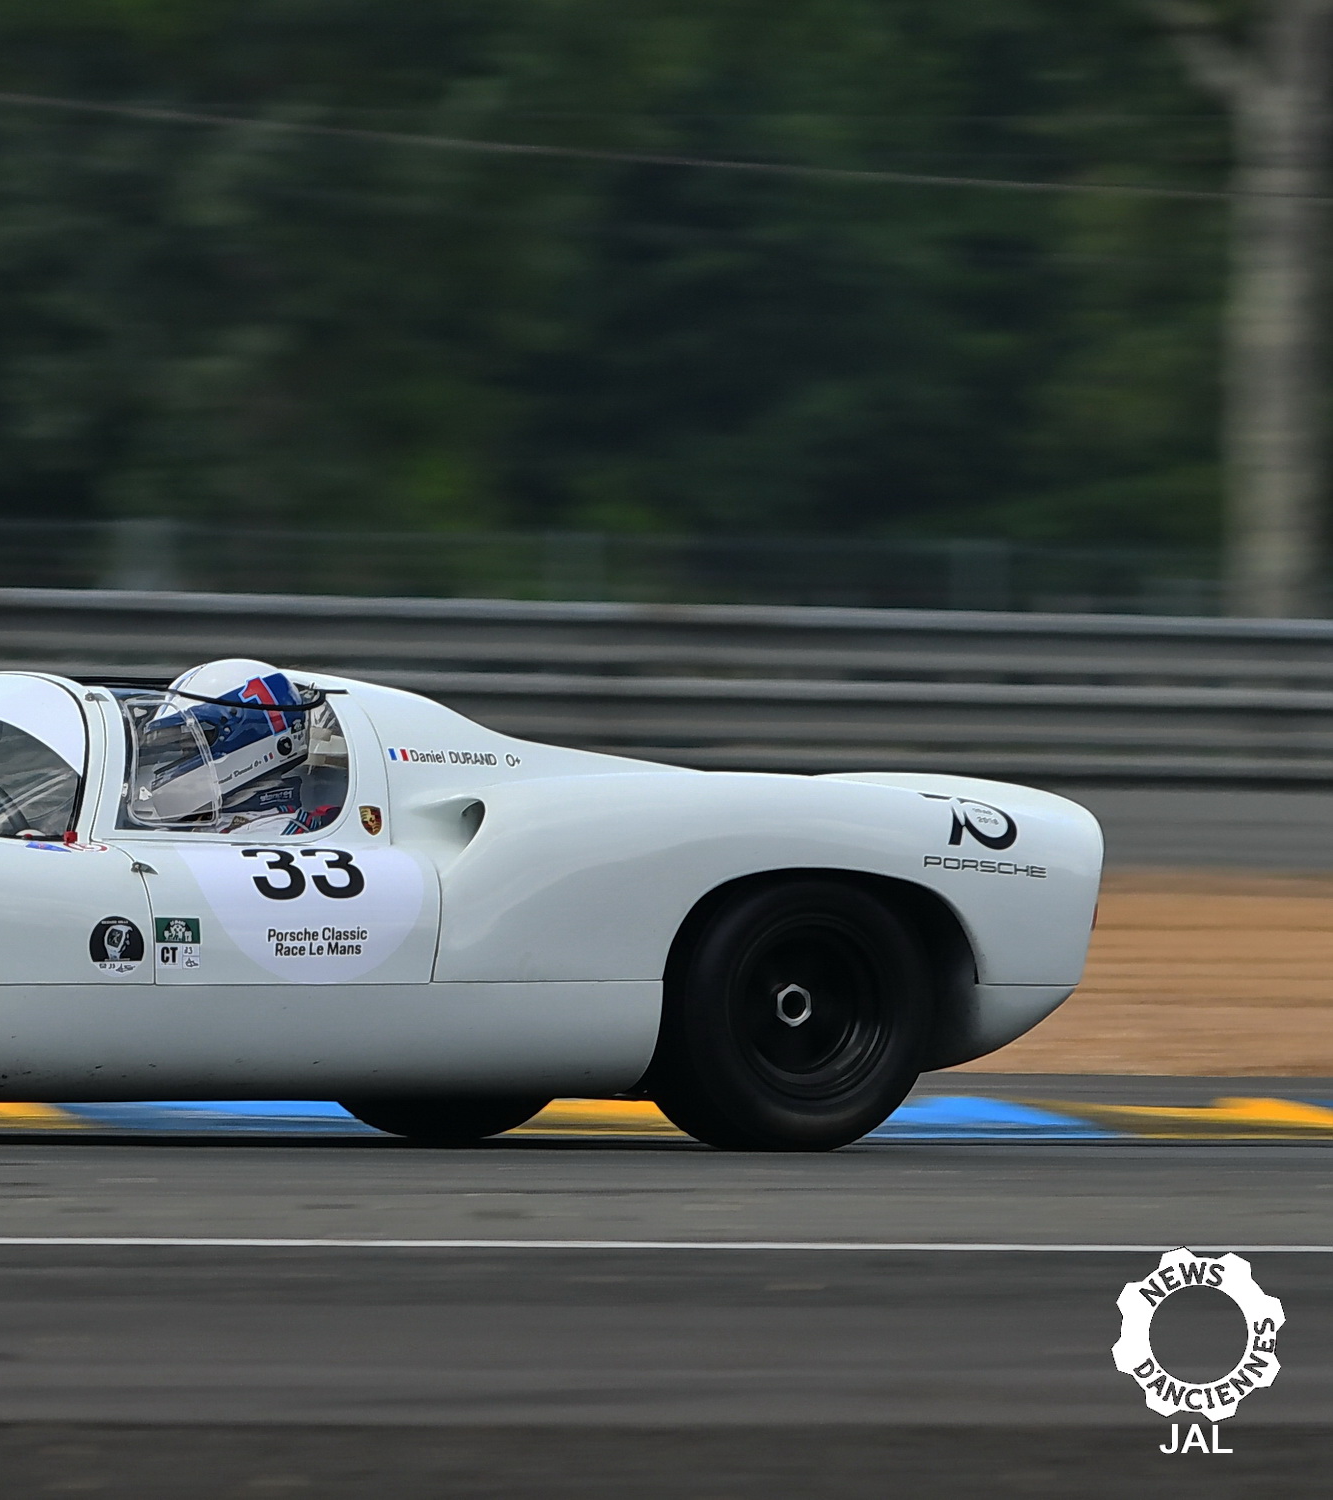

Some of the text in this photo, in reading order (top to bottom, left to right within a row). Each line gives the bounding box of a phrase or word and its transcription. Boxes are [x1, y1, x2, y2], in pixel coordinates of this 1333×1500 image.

[240, 676, 287, 735] 1
[410, 750, 446, 763] Daniel
[449, 752, 497, 765] DURAND
[241, 849, 365, 900] 33
[923, 855, 1047, 878] PORSCHE
[268, 926, 368, 942] Porsche Classic
[161, 946, 178, 963] CT
[275, 942, 362, 956] Race Le Mans
